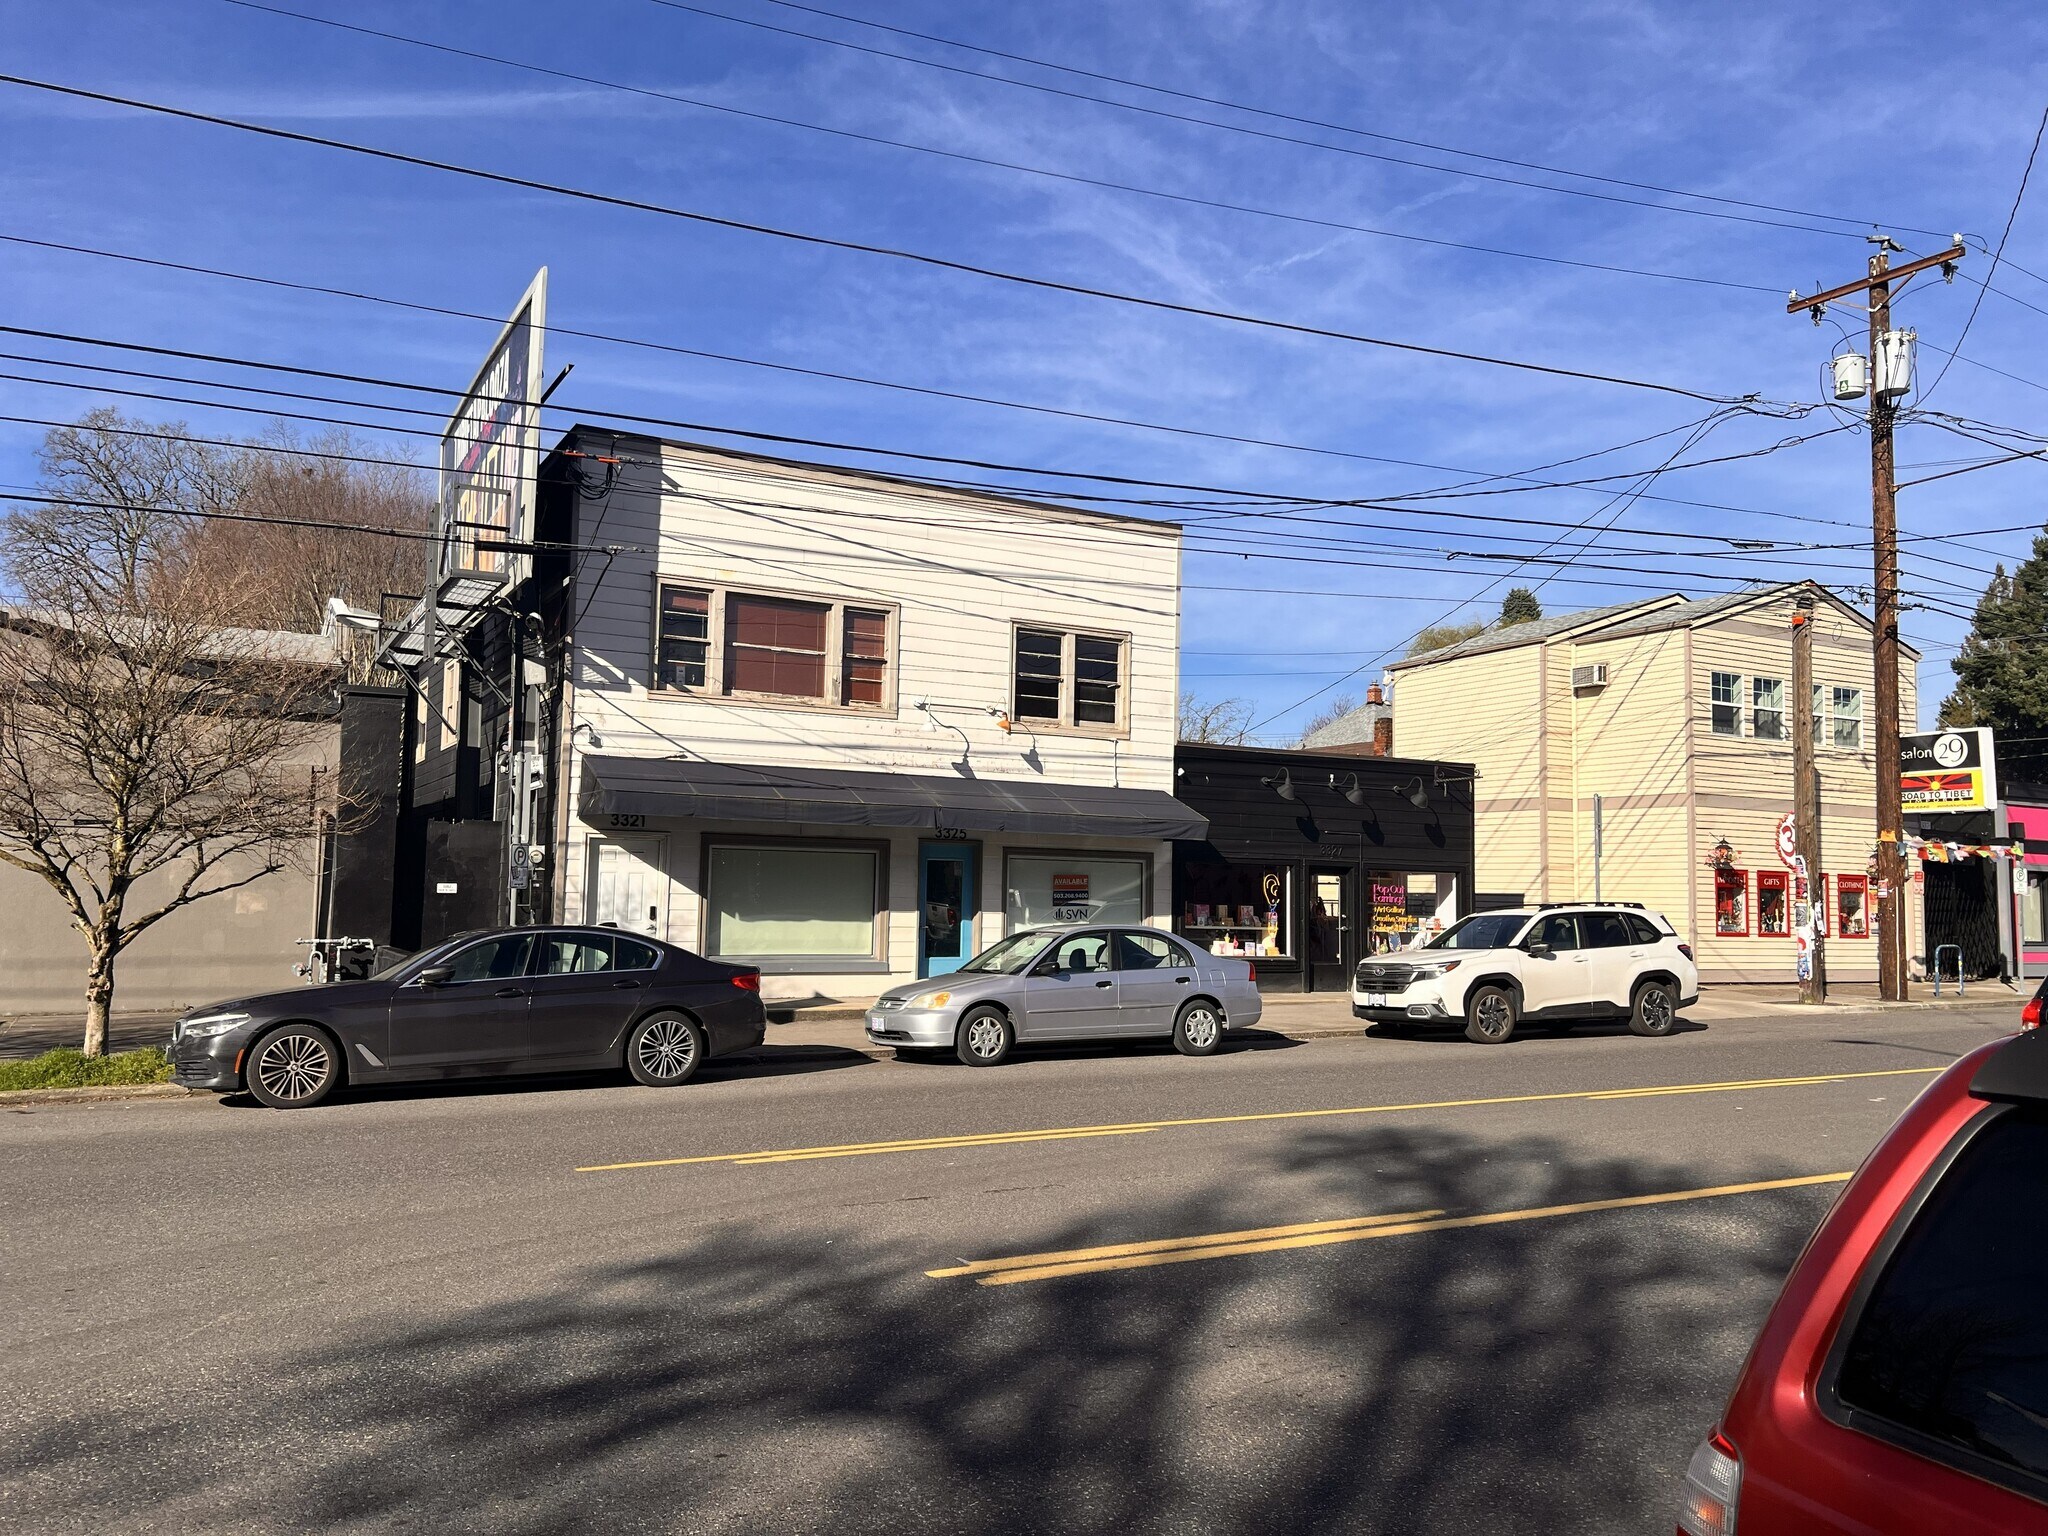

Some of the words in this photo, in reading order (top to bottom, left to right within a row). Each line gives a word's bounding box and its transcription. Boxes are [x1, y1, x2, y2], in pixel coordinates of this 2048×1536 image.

[1901, 746, 1933, 760] salon
[1938, 738, 1964, 763] 29
[1901, 792, 1926, 800] ROAD
[1929, 791, 1941, 799] TO
[1944, 789, 1972, 798] TIBET
[610, 813, 646, 827] 3321
[935, 826, 967, 839] 3325
[1763, 878, 1780, 886] GIFTS
[1838, 881, 1864, 889] CLOTHING
[1373, 883, 1390, 896] Pop
[1390, 884, 1405, 894] Out
[1066, 908, 1088, 920] SVN
